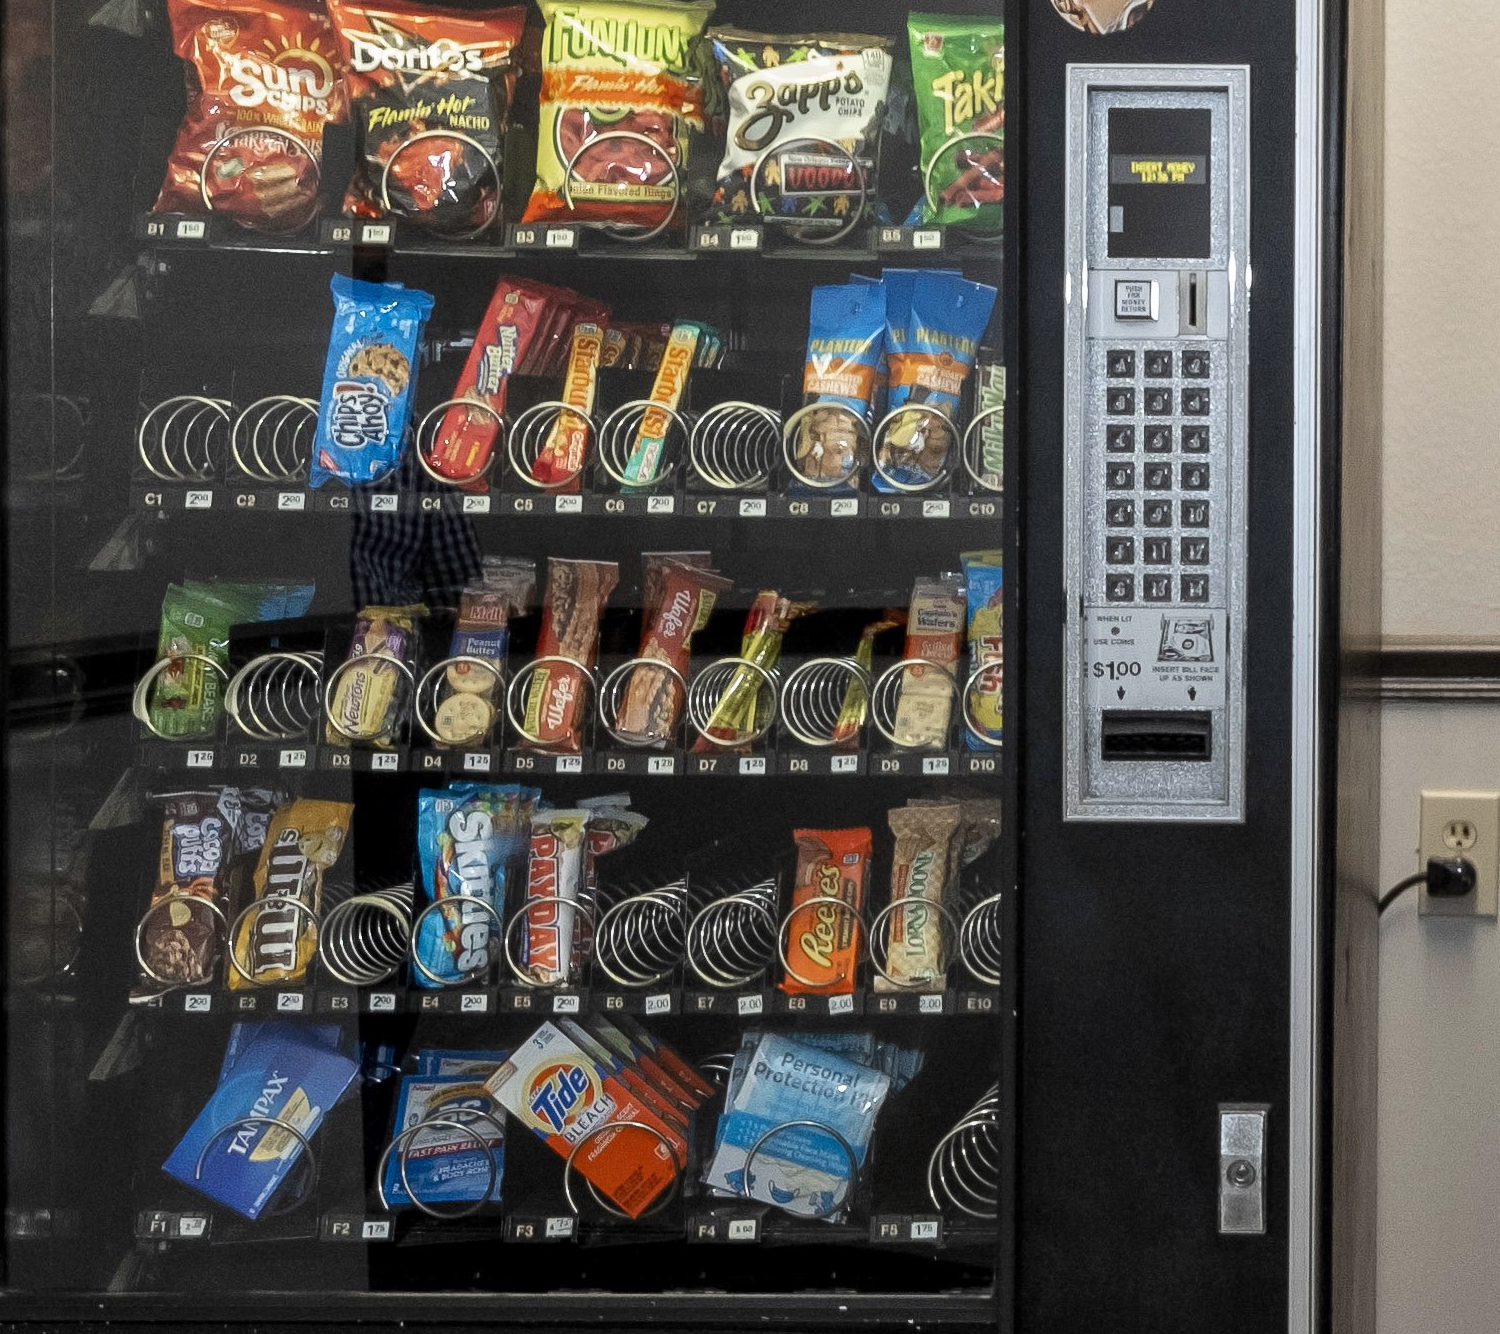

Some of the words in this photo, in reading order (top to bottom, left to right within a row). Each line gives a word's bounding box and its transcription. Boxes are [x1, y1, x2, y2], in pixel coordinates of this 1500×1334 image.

[352, 40, 483, 72] Doritos
[229, 57, 332, 107] Sun
[835, 97, 865, 108] POTATO
[368, 99, 435, 132] Flamin'
[437, 93, 477, 116] Hot
[837, 107, 863, 117] CHIPS
[449, 114, 490, 131] NACHO
[568, 184, 595, 196] nion
[596, 185, 642, 198] Flavored
[334, 393, 366, 448] Chips
[145, 493, 162, 505] C1
[236, 495, 256, 507] C2
[330, 497, 349, 508] C3
[422, 497, 440, 509] C4
[605, 500, 624, 512] C6
[697, 501, 716, 514] C7
[881, 503, 900, 515] C9
[969, 503, 994, 515] C10
[662, 589, 691, 639] Wafer
[917, 608, 958, 619] Captain's
[1097, 615, 1120, 623] WHEN
[917, 617, 957, 629] Wafers
[467, 637, 501, 648] Peanut
[1093, 638, 1109, 646] USE
[466, 646, 496, 656] Butter
[1092, 661, 1142, 681] $1.00
[1152, 666, 1180, 674] INSERT
[1159, 674, 1171, 682] UP
[1171, 674, 1184, 682] AS
[1185, 674, 1214, 682] SHOWN
[201, 680, 217, 723] BEARS
[342, 671, 366, 735] Newtons
[548, 674, 571, 730] Wafer
[240, 754, 257, 765] D2
[333, 755, 350, 766] D3
[424, 756, 441, 767] D4
[516, 758, 534, 769] D5
[607, 759, 625, 770] D6
[699, 759, 717, 770] D7
[790, 759, 808, 771] D8
[882, 760, 900, 771] D9
[970, 759, 994, 771] D10
[528, 833, 559, 973] PAYDAY
[239, 997, 256, 1008] E2
[331, 997, 348, 1008] E3
[422, 997, 439, 1008] E4
[514, 996, 531, 1008] E5
[606, 997, 623, 1008] E6
[647, 997, 669, 1009] 2.00
[698, 997, 714, 1008] E7
[740, 998, 762, 1010] 2.00
[789, 998, 805, 1010] E8
[830, 998, 851, 1010] 2.00
[879, 998, 896, 1010] E9
[967, 998, 991, 1009] E10
[533, 1039, 544, 1050] 3
[781, 1051, 860, 1088] Personal
[753, 1061, 846, 1103] Protection
[531, 1066, 590, 1134] Tide
[227, 1076, 289, 1155] TAMPAX
[564, 1093, 615, 1144] BLEACH
[150, 1220, 166, 1233] F1
[333, 1222, 350, 1234] F2
[516, 1225, 534, 1237] F3
[699, 1225, 716, 1237] F4
